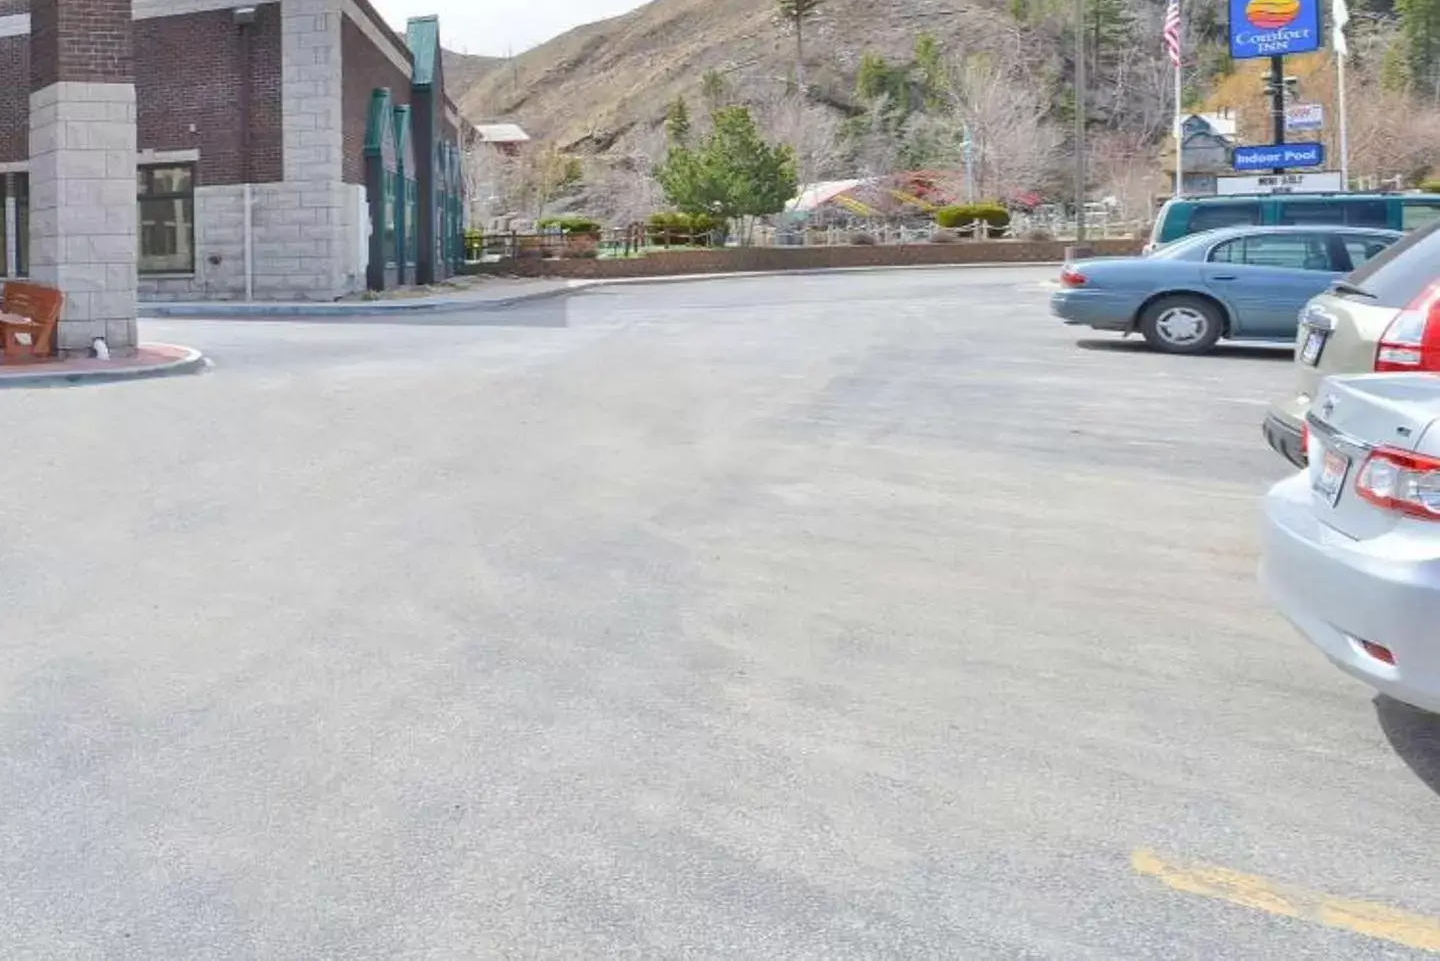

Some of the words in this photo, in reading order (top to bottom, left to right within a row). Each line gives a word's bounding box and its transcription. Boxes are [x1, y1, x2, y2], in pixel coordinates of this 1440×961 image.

[1235, 28, 1310, 45] Comfort
[1258, 41, 1289, 54] INN
[1236, 153, 1281, 164] Indoor
[1285, 149, 1317, 161] Pool
